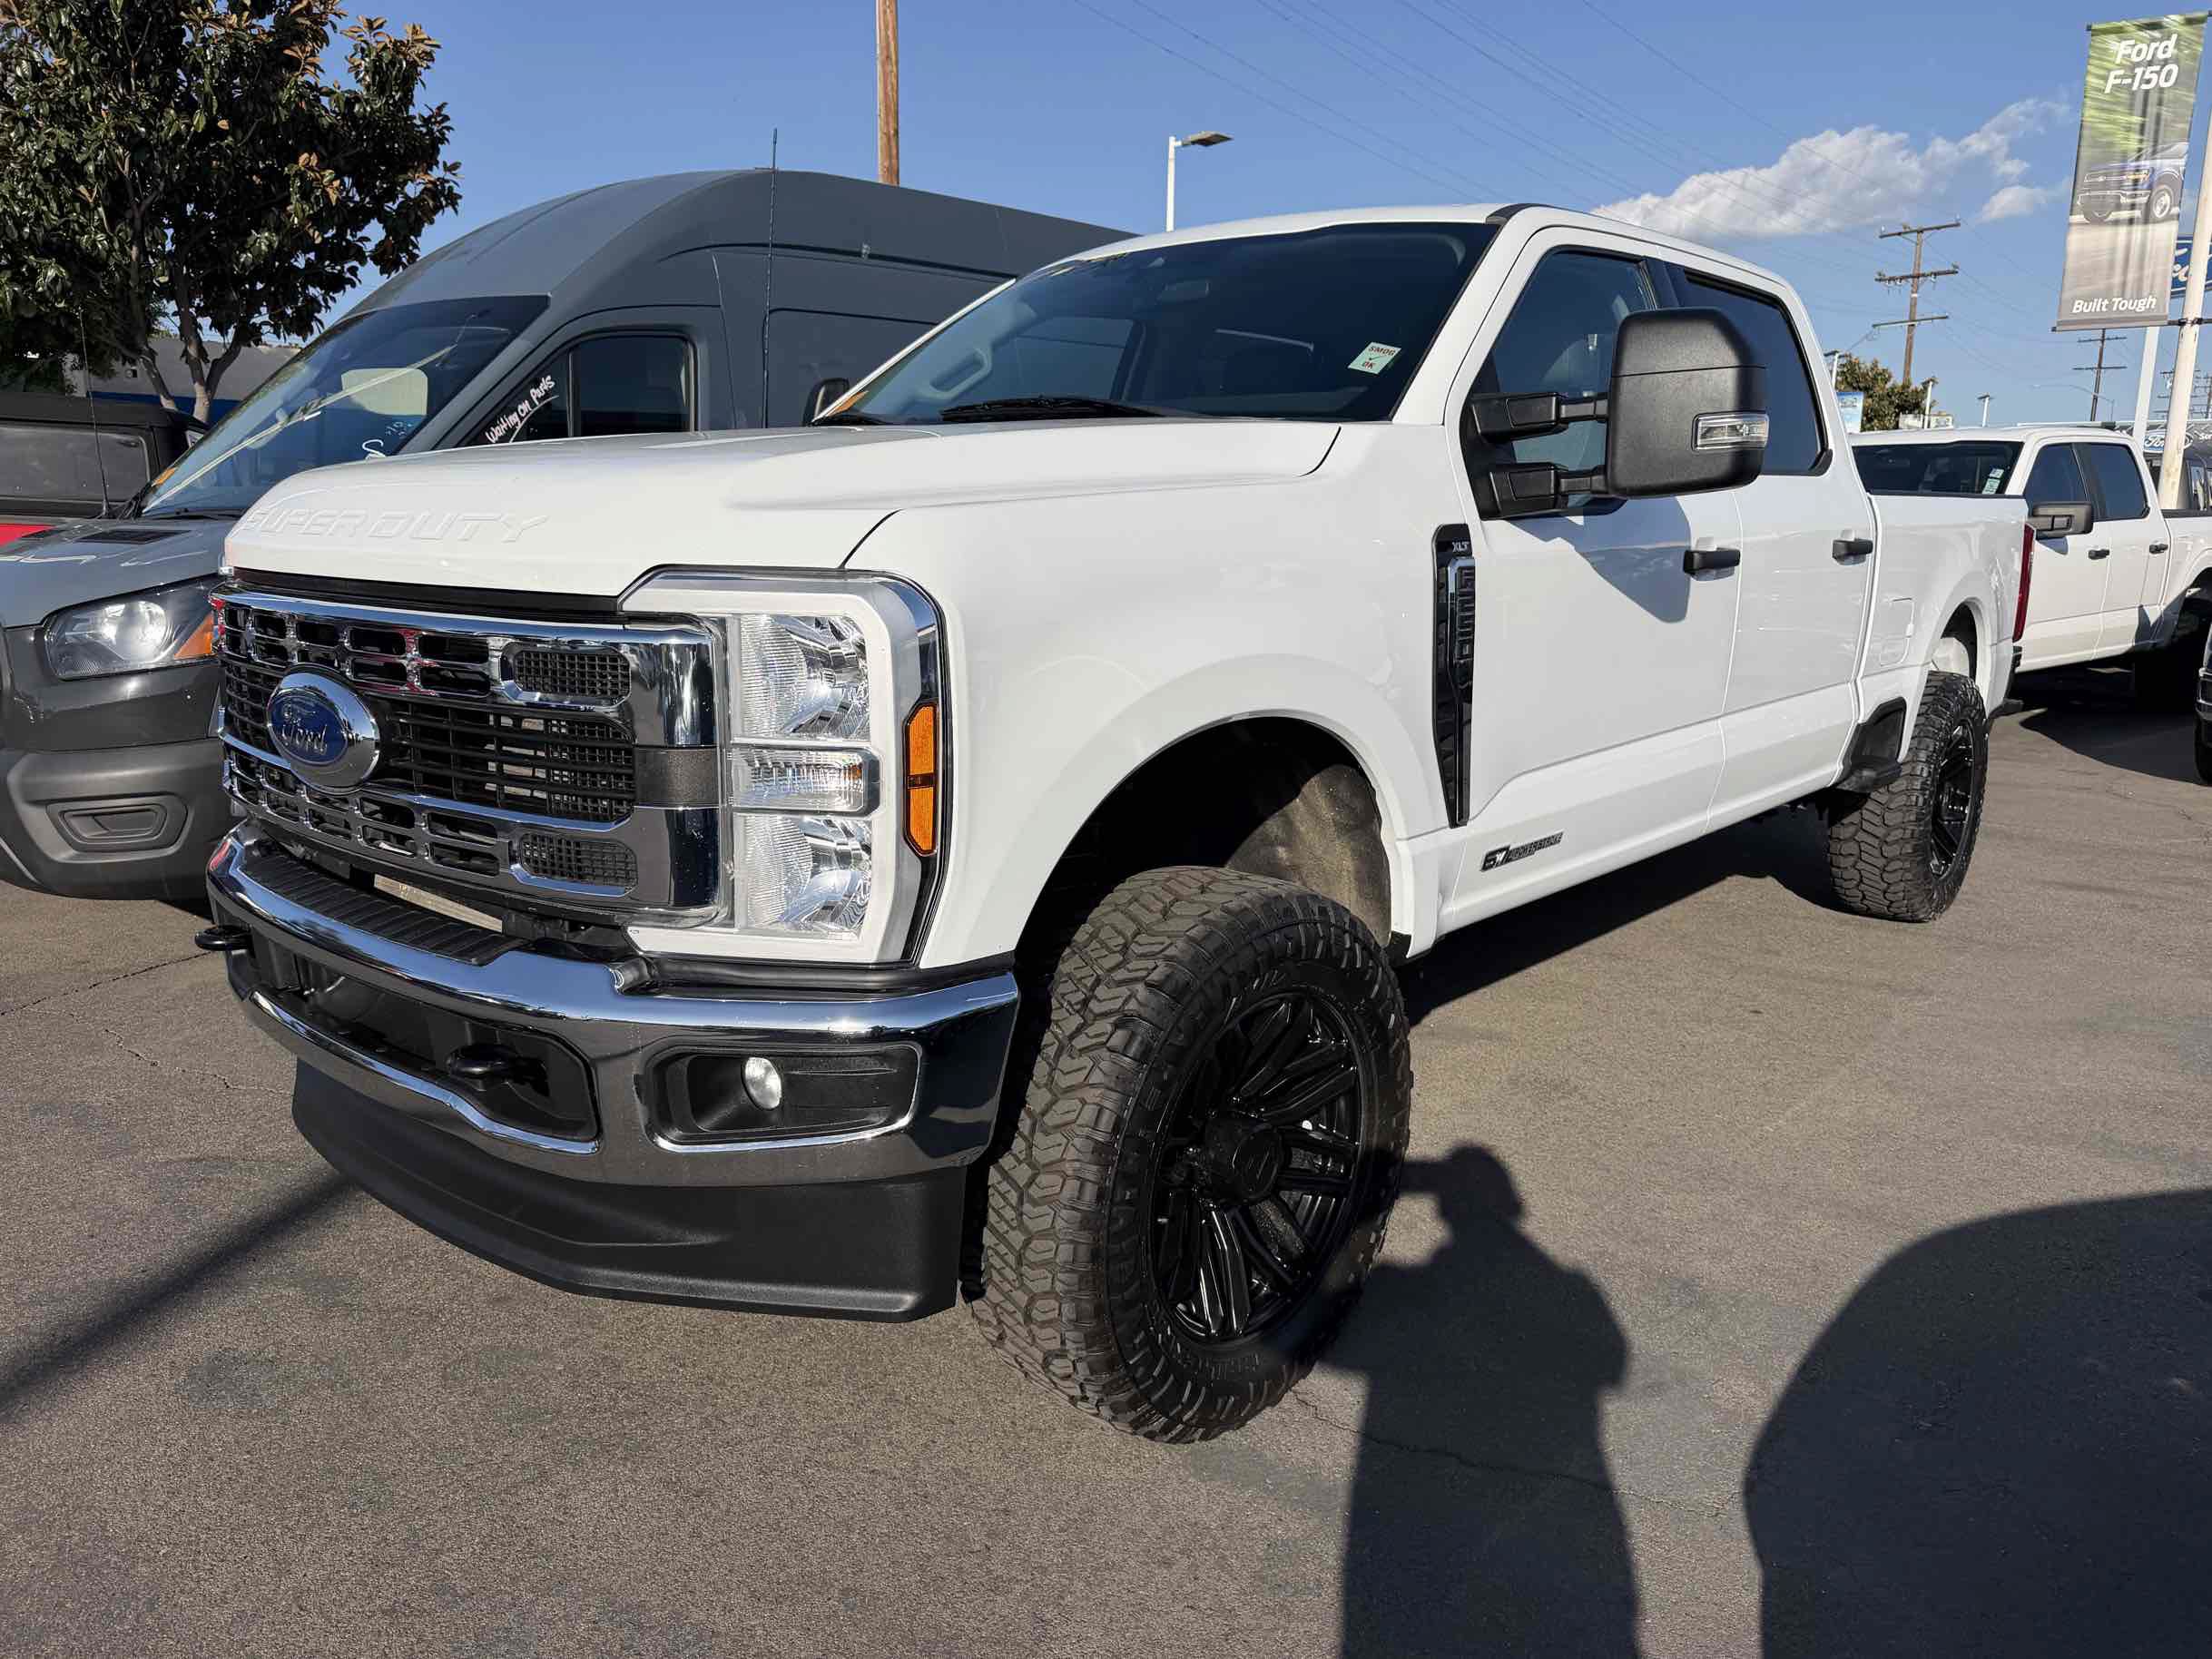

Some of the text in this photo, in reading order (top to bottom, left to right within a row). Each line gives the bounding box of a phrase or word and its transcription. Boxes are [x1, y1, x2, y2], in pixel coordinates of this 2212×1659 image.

[2115, 34, 2178, 64] Ford
[2104, 64, 2178, 93] F-150
[2072, 295, 2157, 313] Built Tough
[1369, 346, 1396, 357] SMOG
[485, 412, 521, 444] Waiting
[240, 506, 548, 545] SUPER DUTY
[1452, 541, 1470, 552] XLT
[280, 701, 329, 755] Ford
